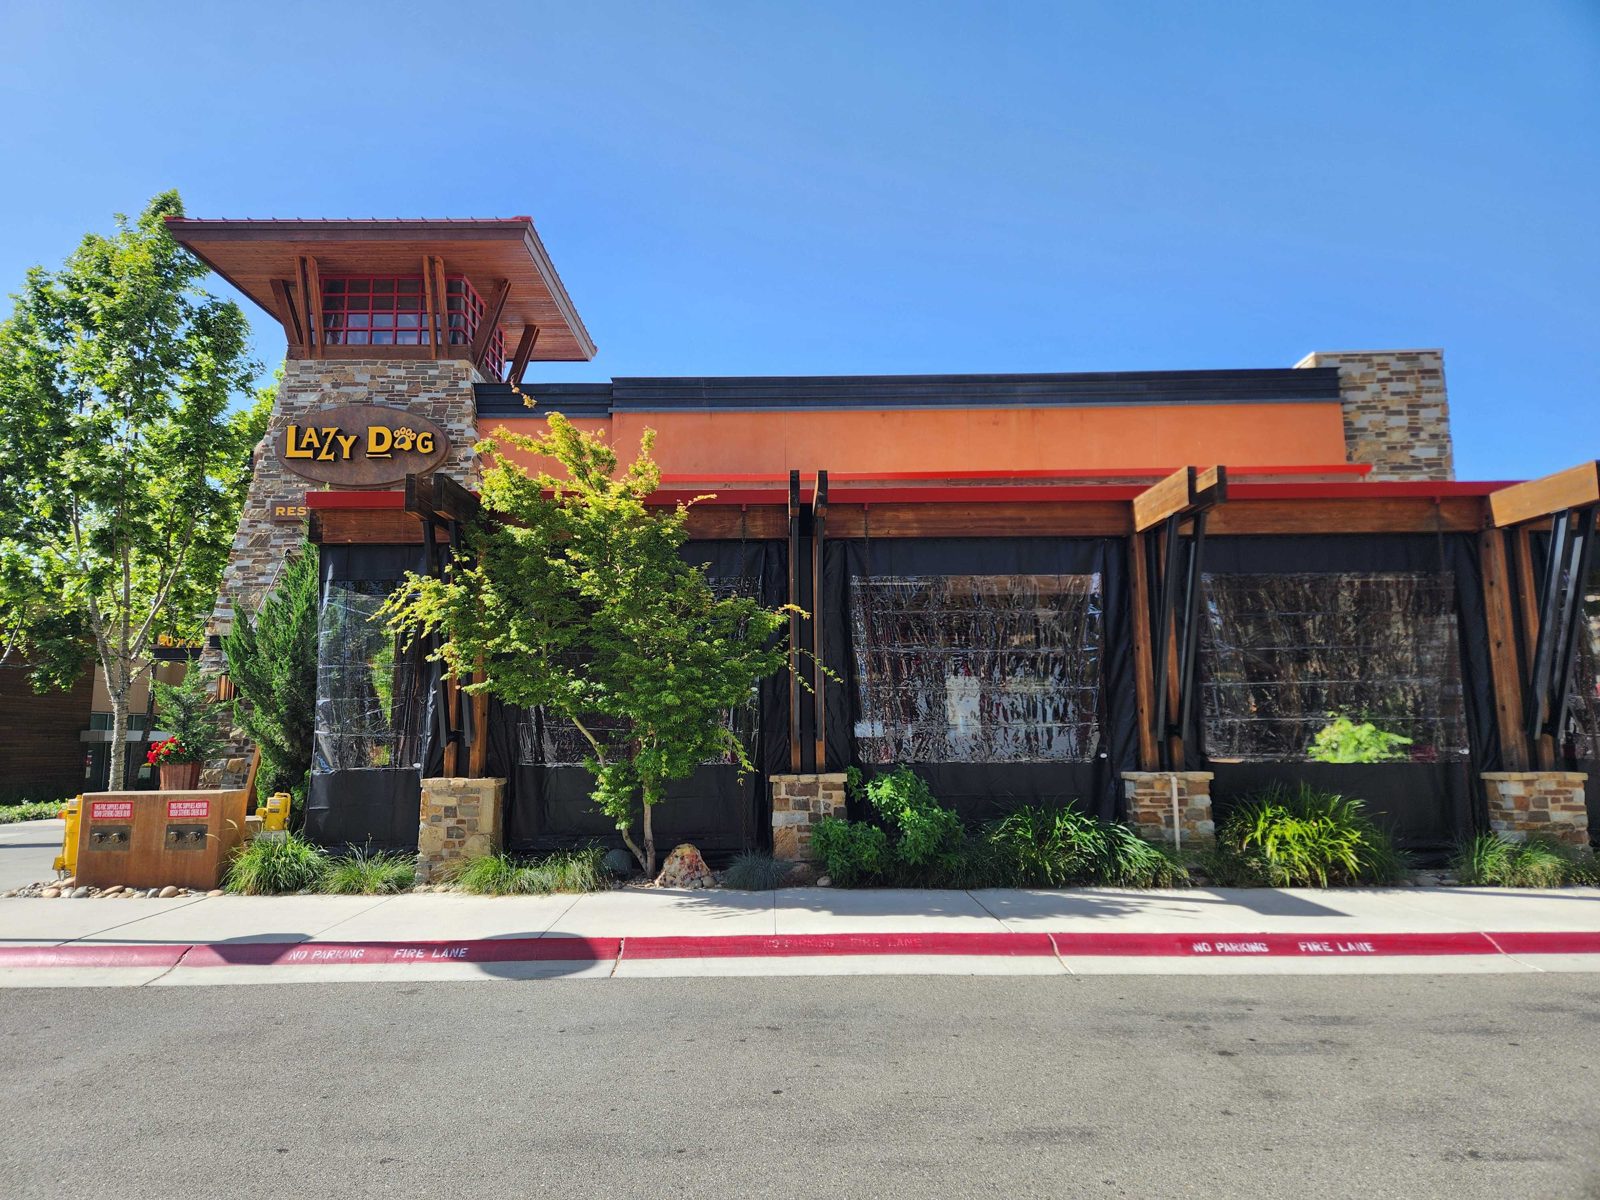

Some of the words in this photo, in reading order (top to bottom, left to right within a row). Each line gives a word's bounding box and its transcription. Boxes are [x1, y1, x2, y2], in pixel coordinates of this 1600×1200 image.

[285, 425, 358, 462] LAZY
[275, 506, 309, 516] RES
[1192, 942, 1212, 953] NO
[1215, 942, 1270, 953] PARKING
[1297, 941, 1334, 952] FIRE
[1337, 941, 1376, 952] LANE
[288, 950, 308, 960] NO
[311, 949, 365, 960] PARKING
[393, 948, 425, 959] FIRE
[432, 947, 470, 958] LANE
